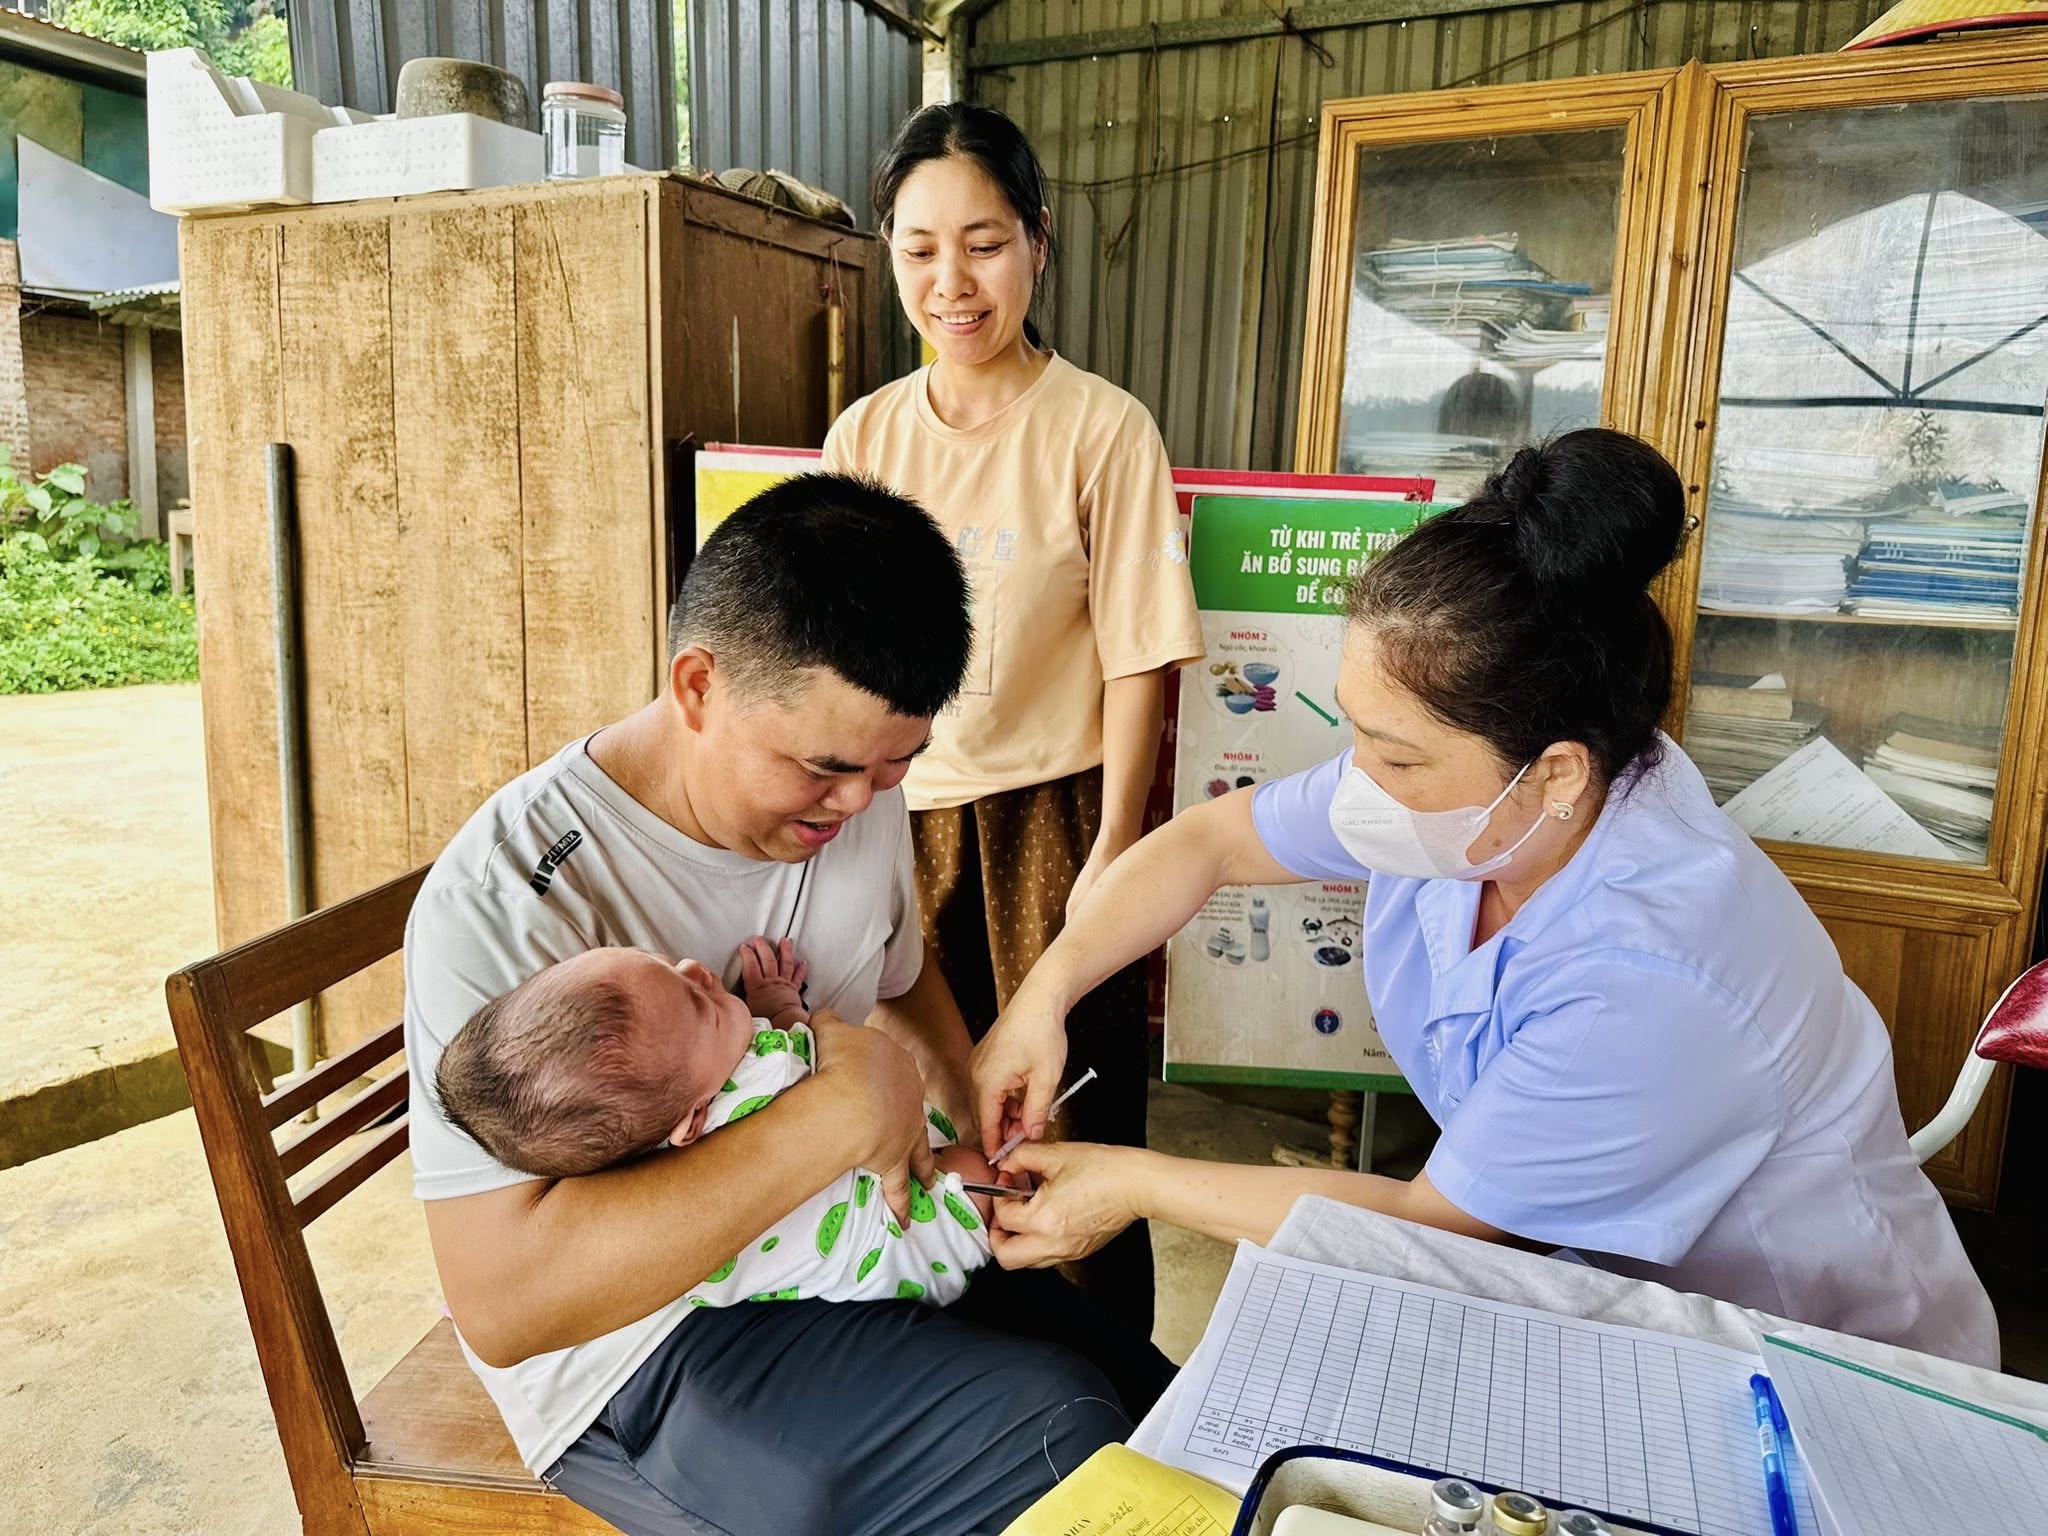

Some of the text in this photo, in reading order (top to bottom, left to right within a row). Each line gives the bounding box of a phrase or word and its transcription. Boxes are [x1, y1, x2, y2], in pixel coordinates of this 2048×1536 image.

[1270, 524, 1292, 548] TỪ
[1296, 530, 1326, 549] KHI
[1331, 527, 1361, 550] TRẺ
[1240, 551, 1263, 573] ĂN
[1268, 549, 1292, 575] BỔ
[1296, 557, 1341, 576] SUNG
[1296, 579, 1320, 603] ĐỂ
[1230, 631, 1268, 641] NHÓM 2
[1223, 752, 1252, 761] NHÓM
[1322, 884, 1360, 894] NHÓM 5
[1363, 1048, 1386, 1058] Năm
